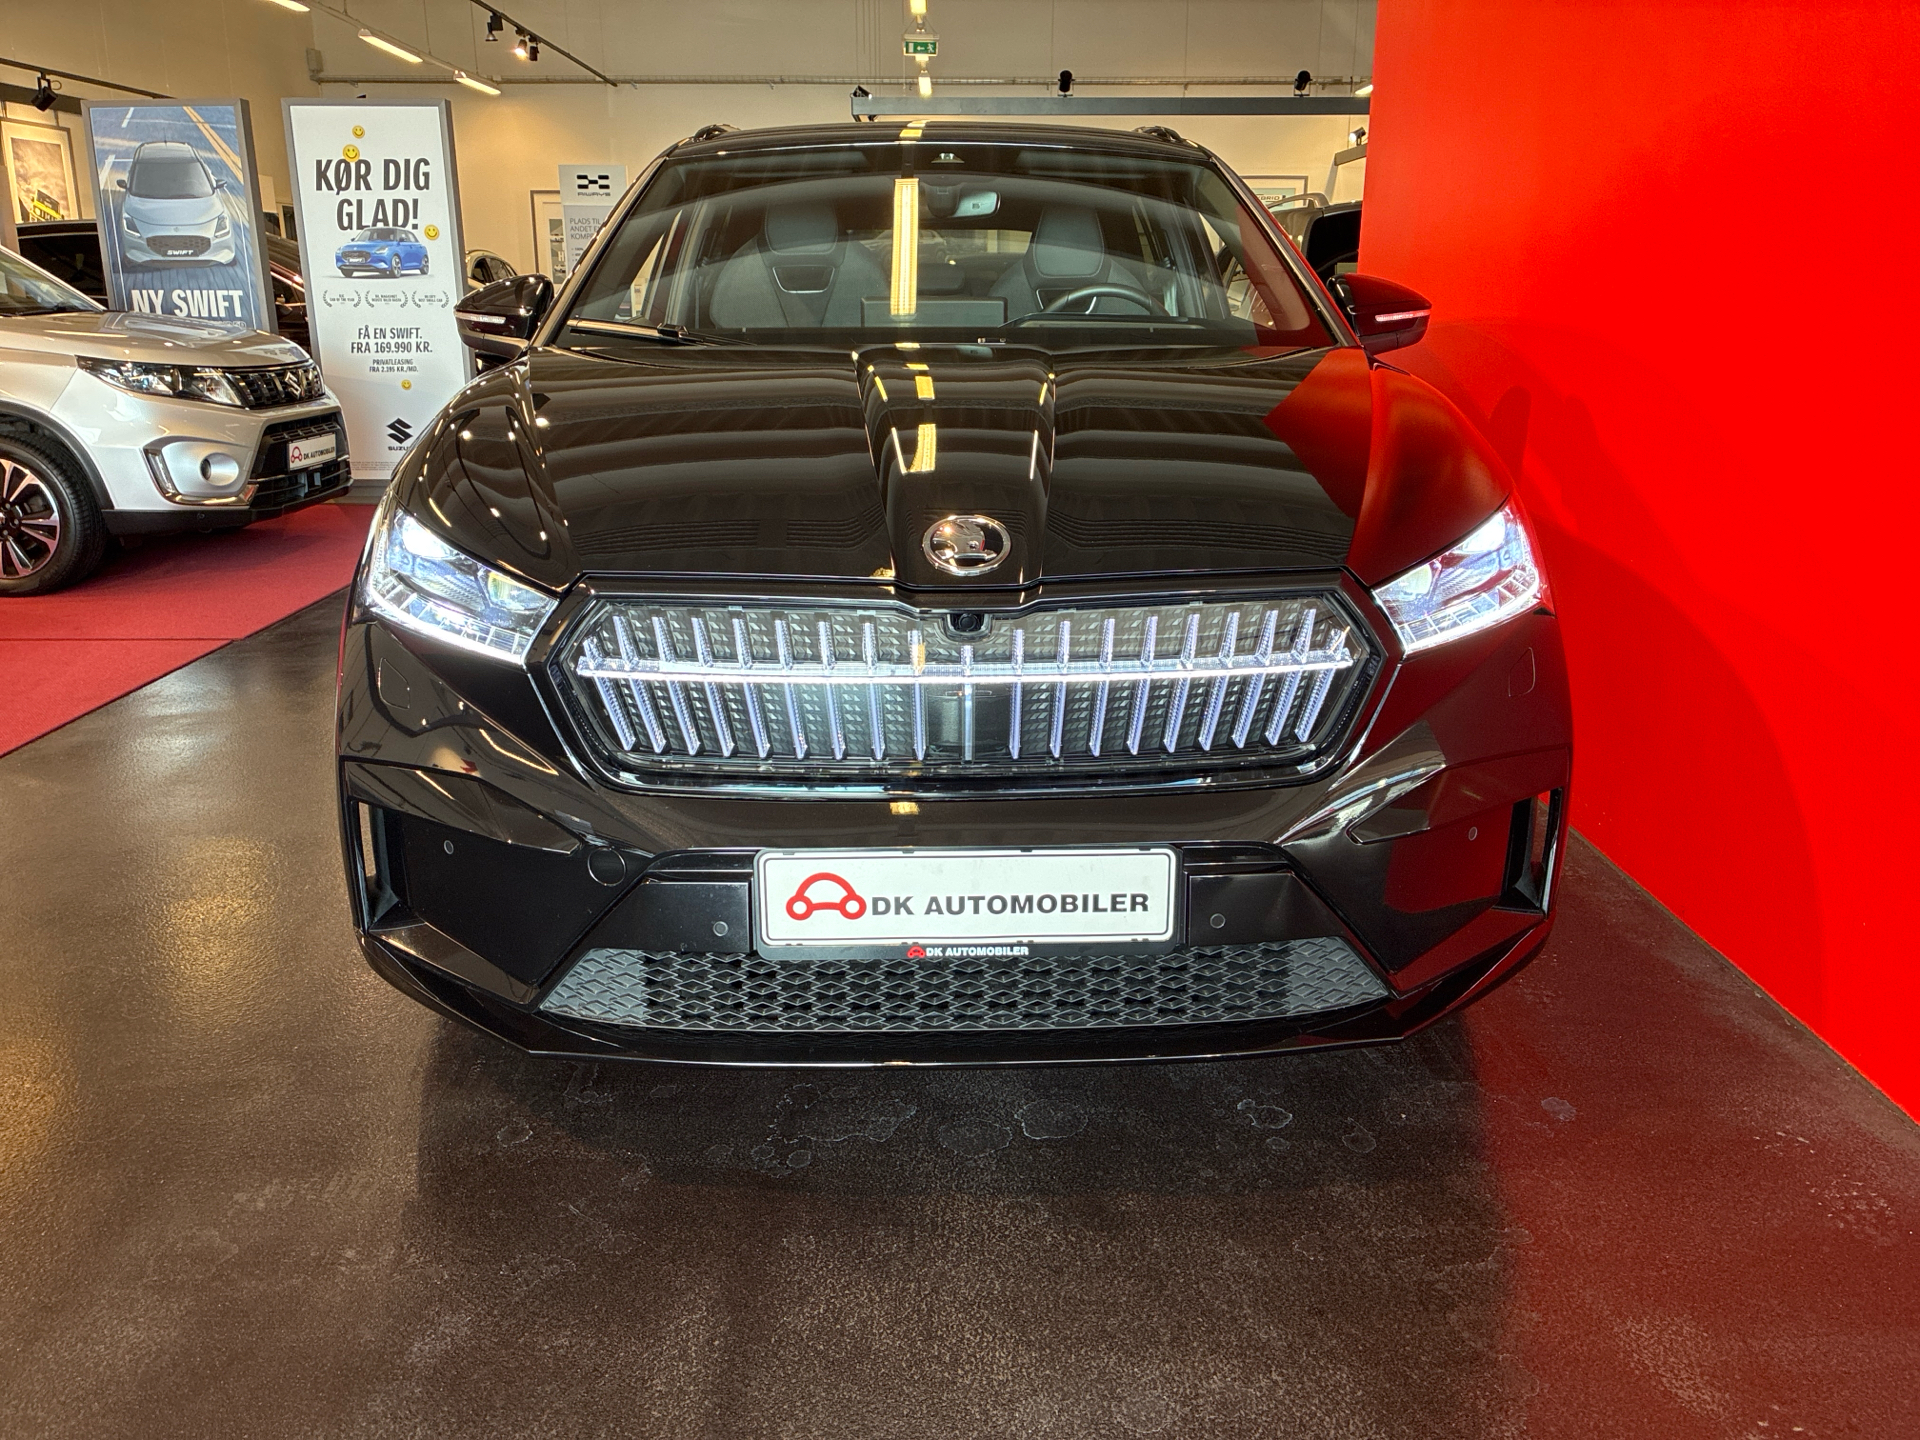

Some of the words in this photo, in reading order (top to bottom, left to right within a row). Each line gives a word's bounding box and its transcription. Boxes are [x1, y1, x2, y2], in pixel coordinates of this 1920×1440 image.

[315, 158, 373, 195] KØR
[383, 157, 431, 191] DIG
[336, 198, 419, 231] GLAD!
[569, 217, 591, 225] PLADS
[131, 289, 165, 315] NY
[171, 288, 244, 318] SWIFT
[358, 325, 371, 340] FÅ
[373, 327, 387, 340] EN
[389, 327, 423, 340] SWIFT.
[351, 342, 371, 354] FRA
[374, 341, 412, 354] 169.990
[415, 341, 433, 353] KR.
[372, 358, 414, 366] PRIVATLEASING
[871, 895, 915, 916] DK
[924, 893, 1149, 915] AUTOMOBILER
[926, 947, 943, 957] DK
[947, 946, 1029, 957] AUTOMOBILER
